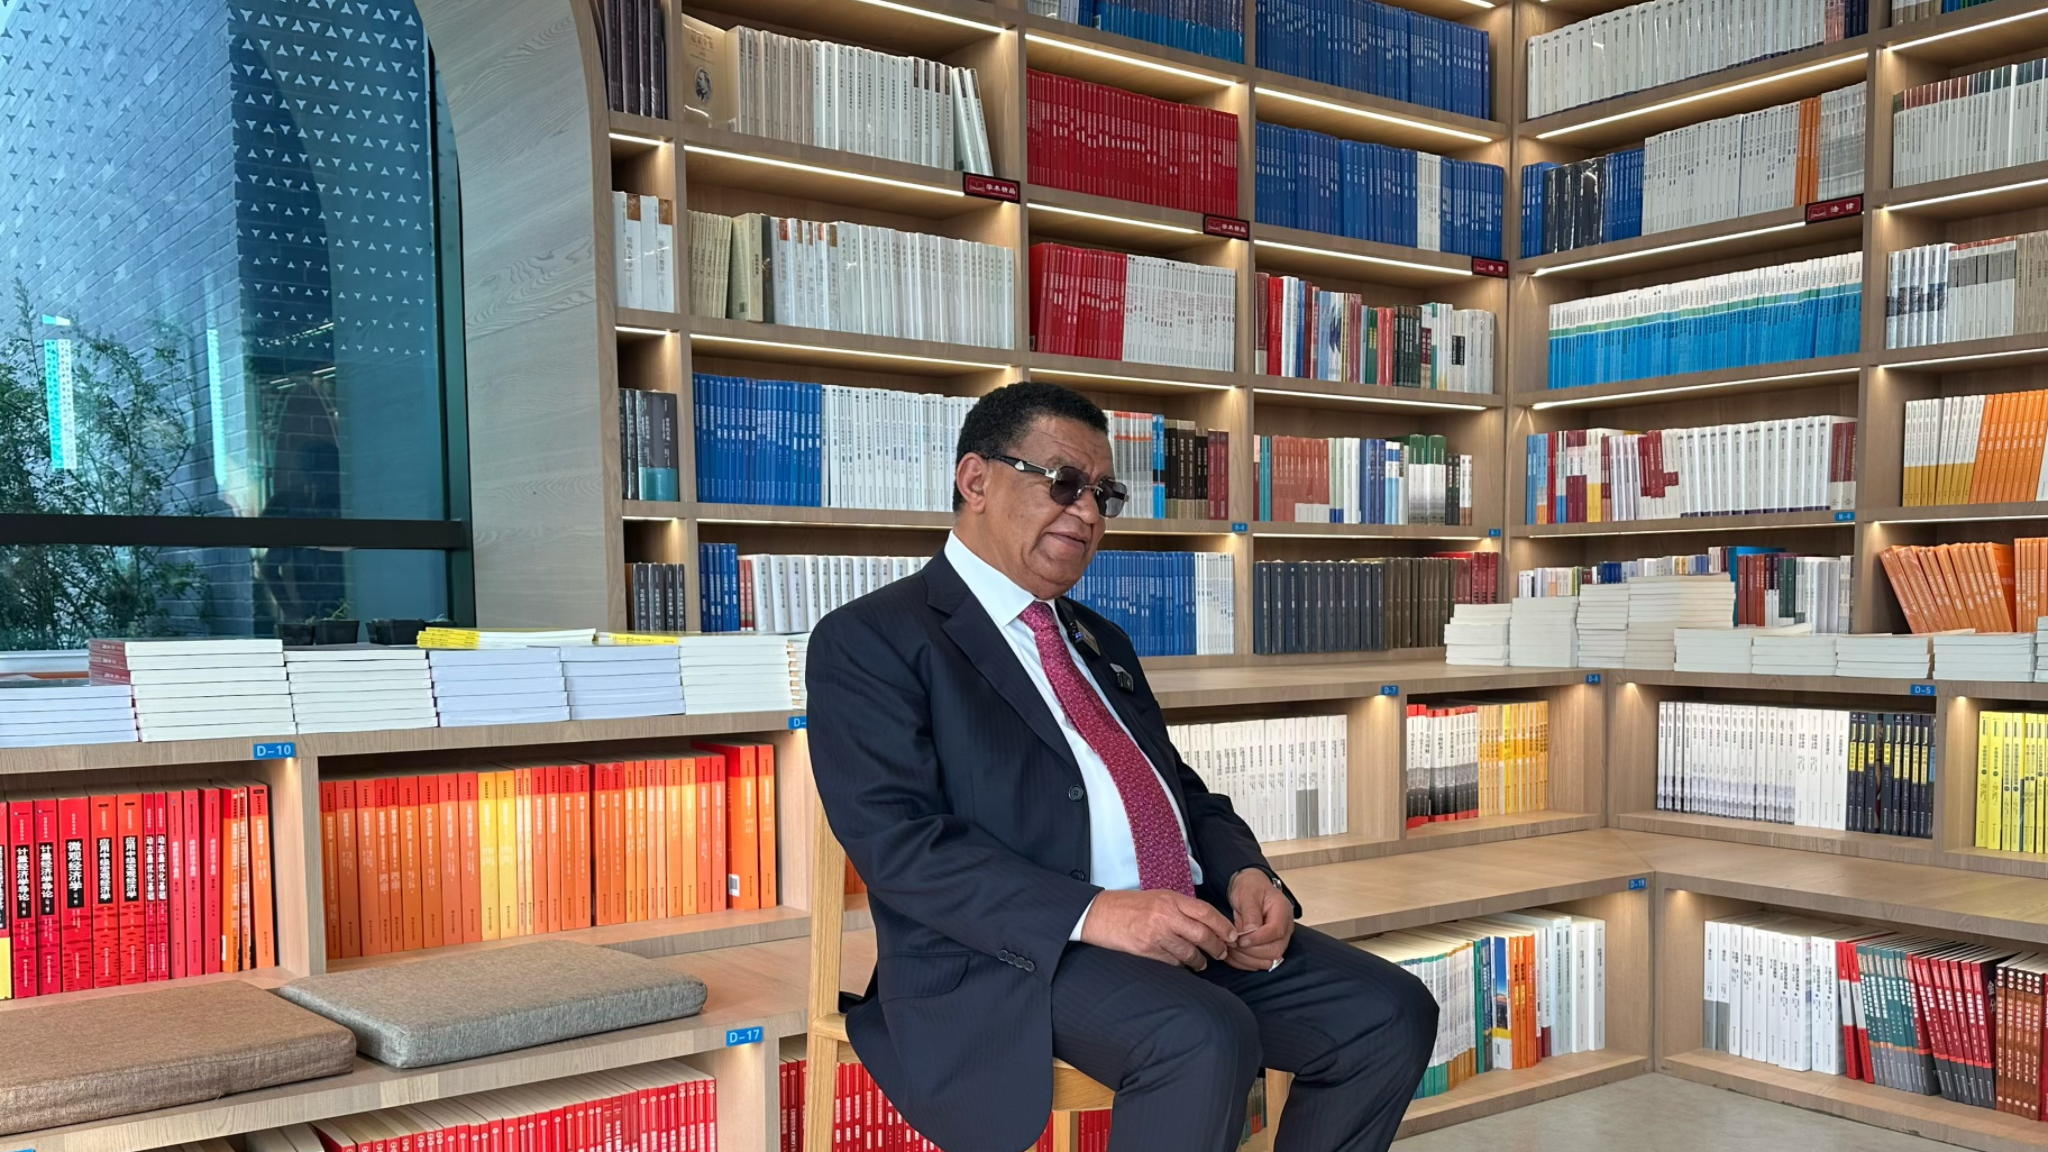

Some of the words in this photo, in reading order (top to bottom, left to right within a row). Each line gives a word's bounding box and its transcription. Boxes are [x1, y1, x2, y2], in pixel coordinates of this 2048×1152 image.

[1914, 685, 1931, 694] D-5
[793, 717, 807, 727] D-
[256, 744, 292, 757] D-10
[40, 844, 54, 898] 计量经济学导论
[67, 841, 83, 891] 微观经济学
[16, 847, 30, 902] 计量经济学导论
[729, 1029, 760, 1043] D-17
